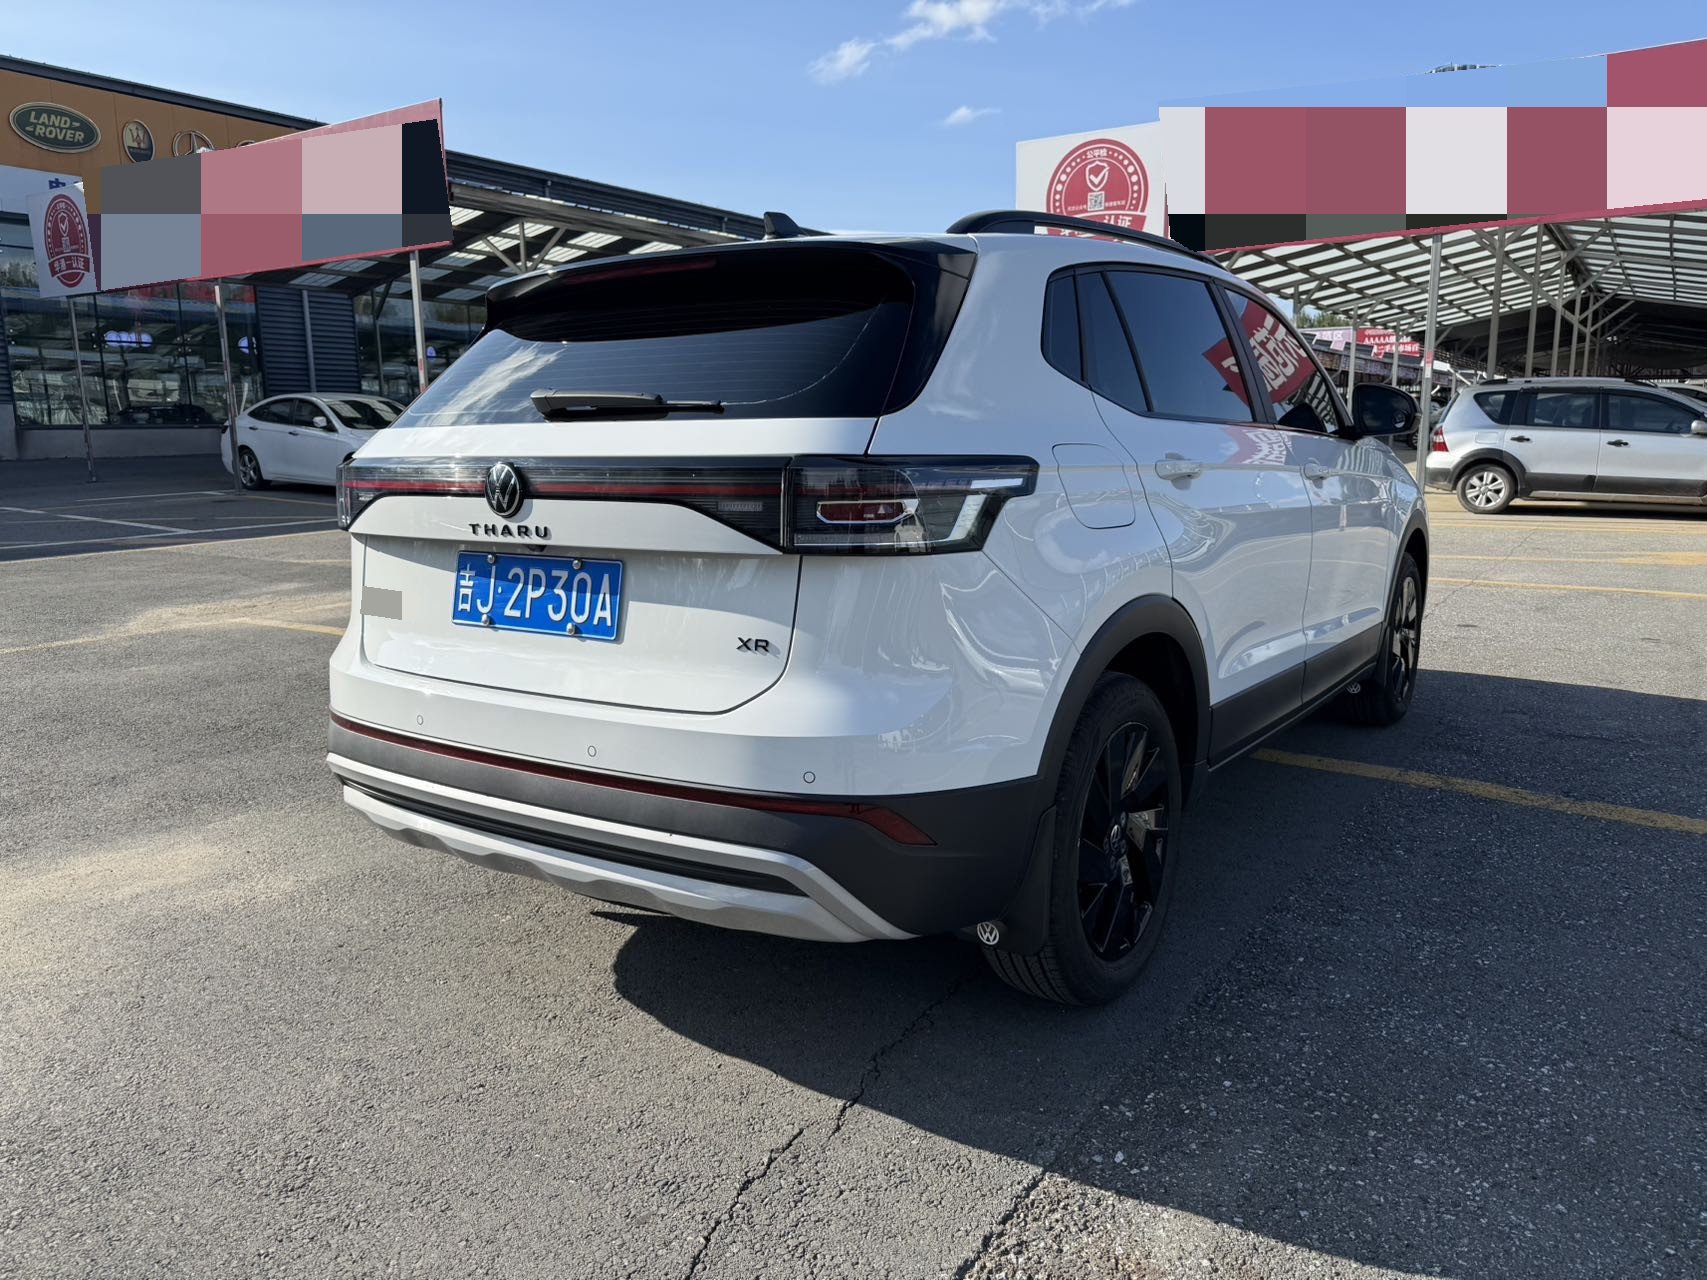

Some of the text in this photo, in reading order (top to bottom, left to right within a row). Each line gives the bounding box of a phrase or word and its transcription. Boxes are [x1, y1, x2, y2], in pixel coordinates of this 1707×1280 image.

[29, 111, 71, 128] LAND
[35, 124, 85, 143] ROVER
[469, 523, 549, 539] THARU
[737, 637, 770, 653] XR
